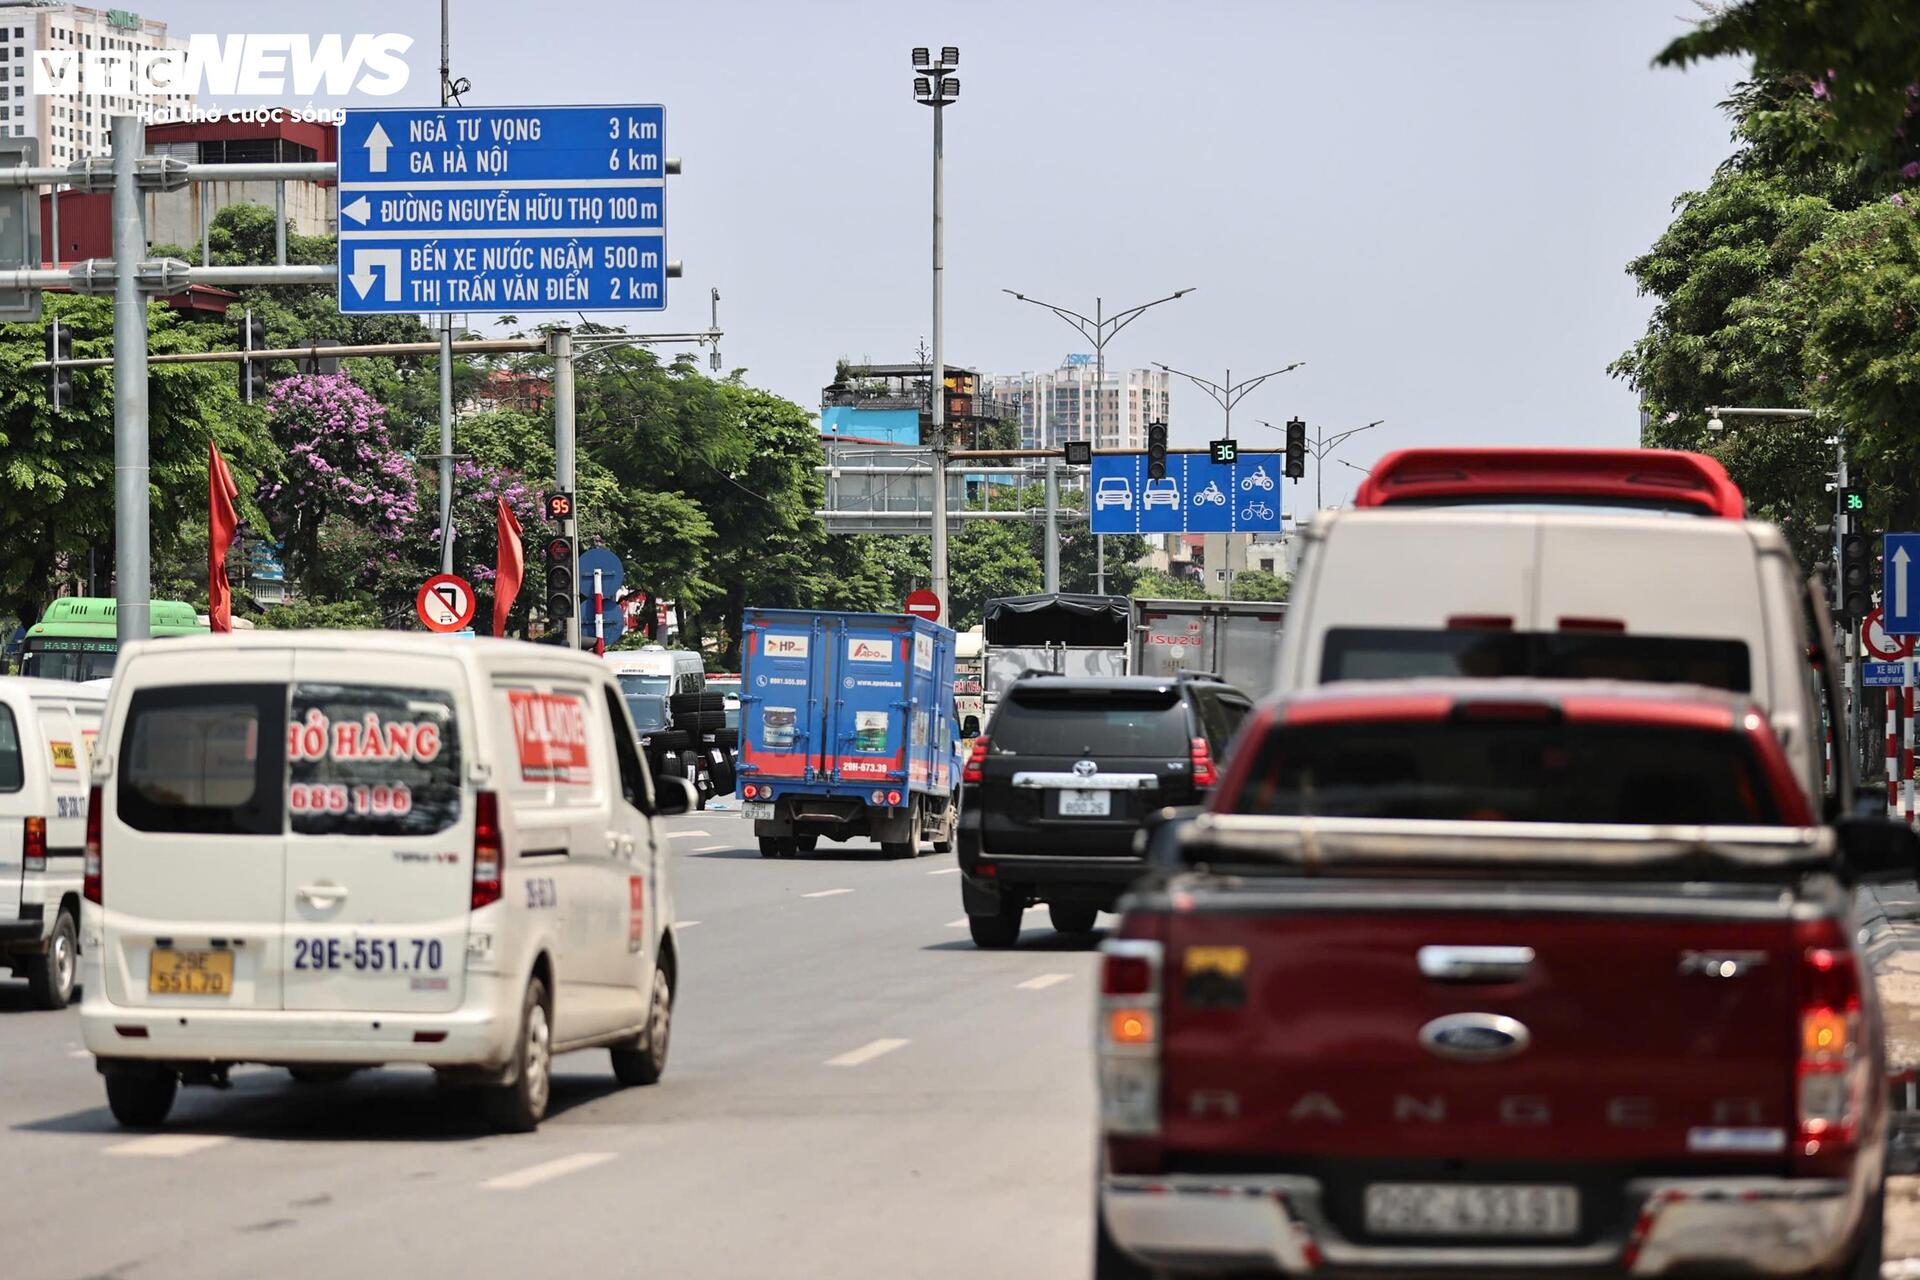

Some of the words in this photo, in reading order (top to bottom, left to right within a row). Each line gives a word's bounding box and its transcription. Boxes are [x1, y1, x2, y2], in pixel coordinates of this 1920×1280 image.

[410, 115, 447, 142] NGÃ
[457, 118, 482, 142] TƯ
[491, 118, 541, 145] VỌNG
[609, 118, 620, 139] 3
[628, 117, 657, 139] km
[410, 151, 433, 173] GA
[443, 144, 467, 173] HÀ
[477, 146, 508, 176] NỘI
[609, 149, 620, 171] 6
[628, 148, 657, 171] km
[381, 193, 443, 222] ĐƯỜNG
[448, 190, 520, 221] NGUYỄN
[526, 191, 563, 221] HỮU
[568, 198, 603, 224] THỌ
[410, 241, 447, 271] BẾN
[453, 248, 476, 271] XE
[483, 240, 534, 270] NƯỚC
[540, 239, 594, 270] NGẦM
[411, 279, 440, 305] THỊ
[447, 272, 496, 302] TRẤN
[503, 275, 539, 301] VĂN
[546, 265, 589, 301] ĐIỂN
[610, 278, 621, 299] 2
[629, 277, 658, 299] km
[1217, 445, 1234, 460] 36
[552, 499, 569, 514] 95
[1848, 494, 1863, 509] 36
[779, 641, 795, 652] HP
[1150, 635, 1204, 645] ISUZU
[331, 712, 441, 763] HÀNG
[289, 782, 348, 816] 685
[294, 938, 444, 970] 29E-551.70
[158, 972, 224, 993] 551.70
